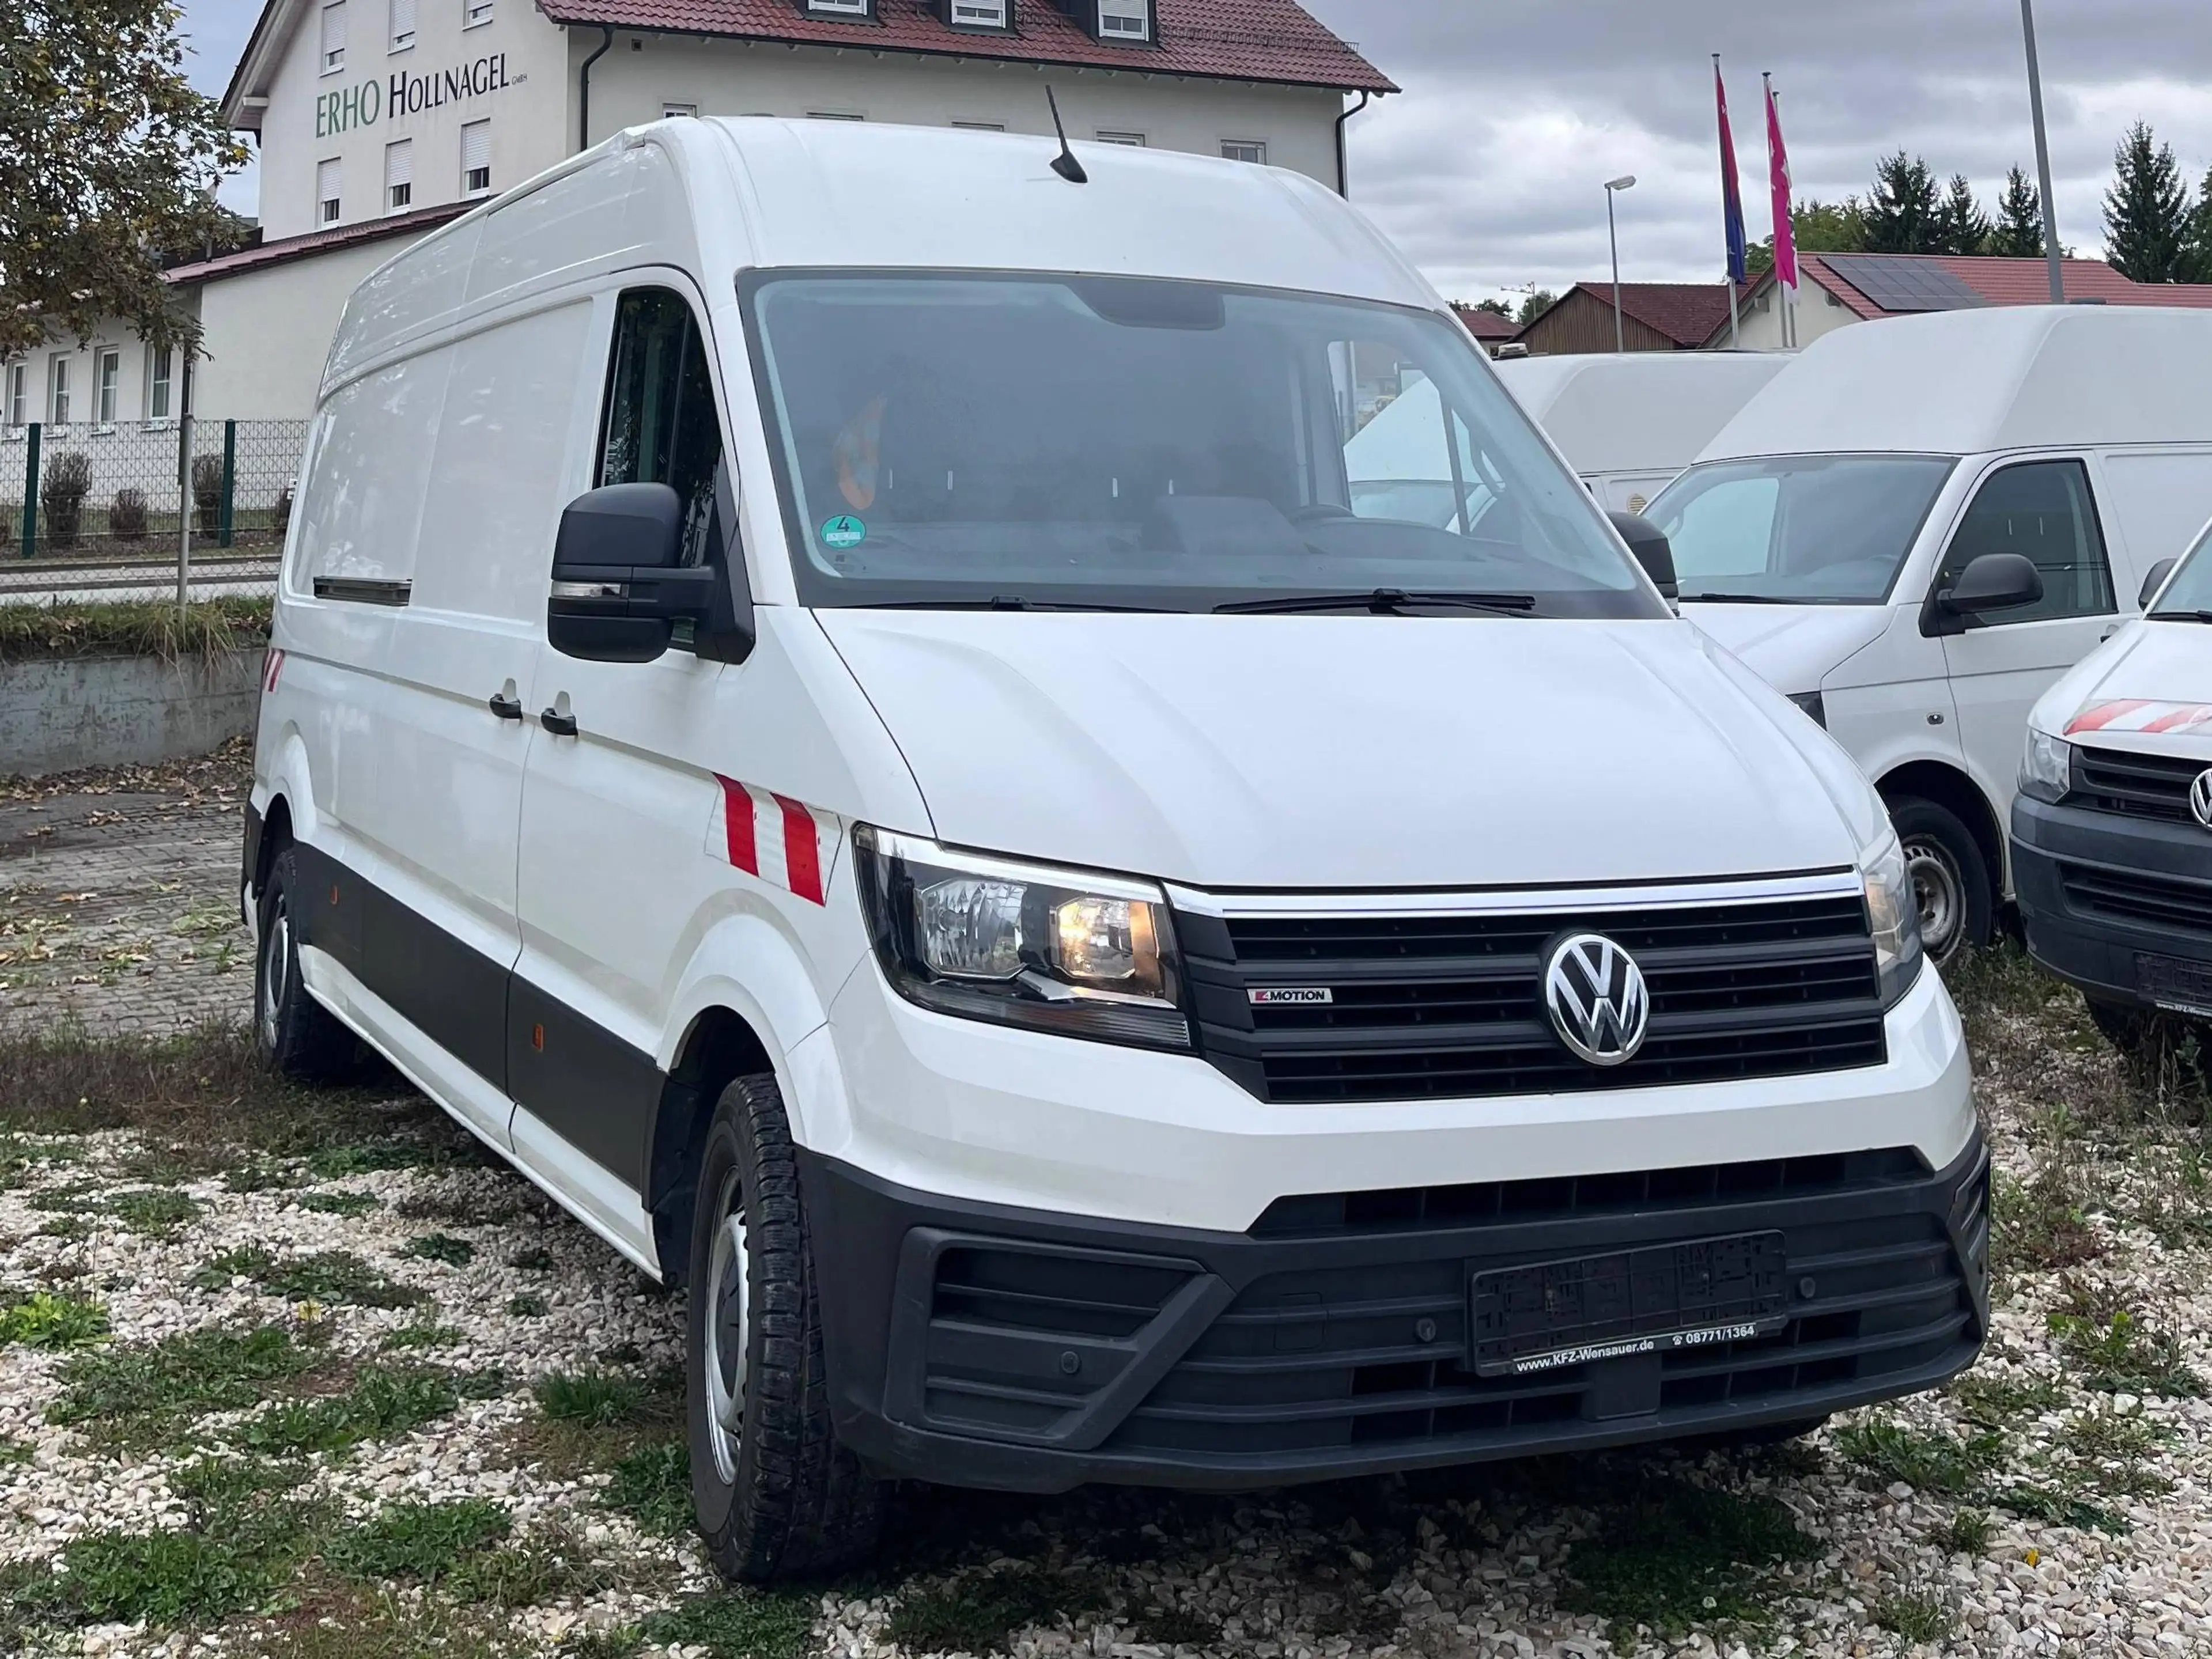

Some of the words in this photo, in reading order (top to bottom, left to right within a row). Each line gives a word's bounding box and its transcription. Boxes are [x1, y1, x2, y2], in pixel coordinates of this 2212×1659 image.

[316, 79, 380, 139] ERHO
[389, 52, 510, 119] HOLLNAGEL
[837, 516, 850, 532] 4
[1255, 990, 1325, 1002] 4MOTION
[1546, 934, 1648, 1066] VW
[1517, 1339, 1654, 1372] www.KFZ-Wensauer.de
[1685, 1325, 1755, 1344] 08771/1364
